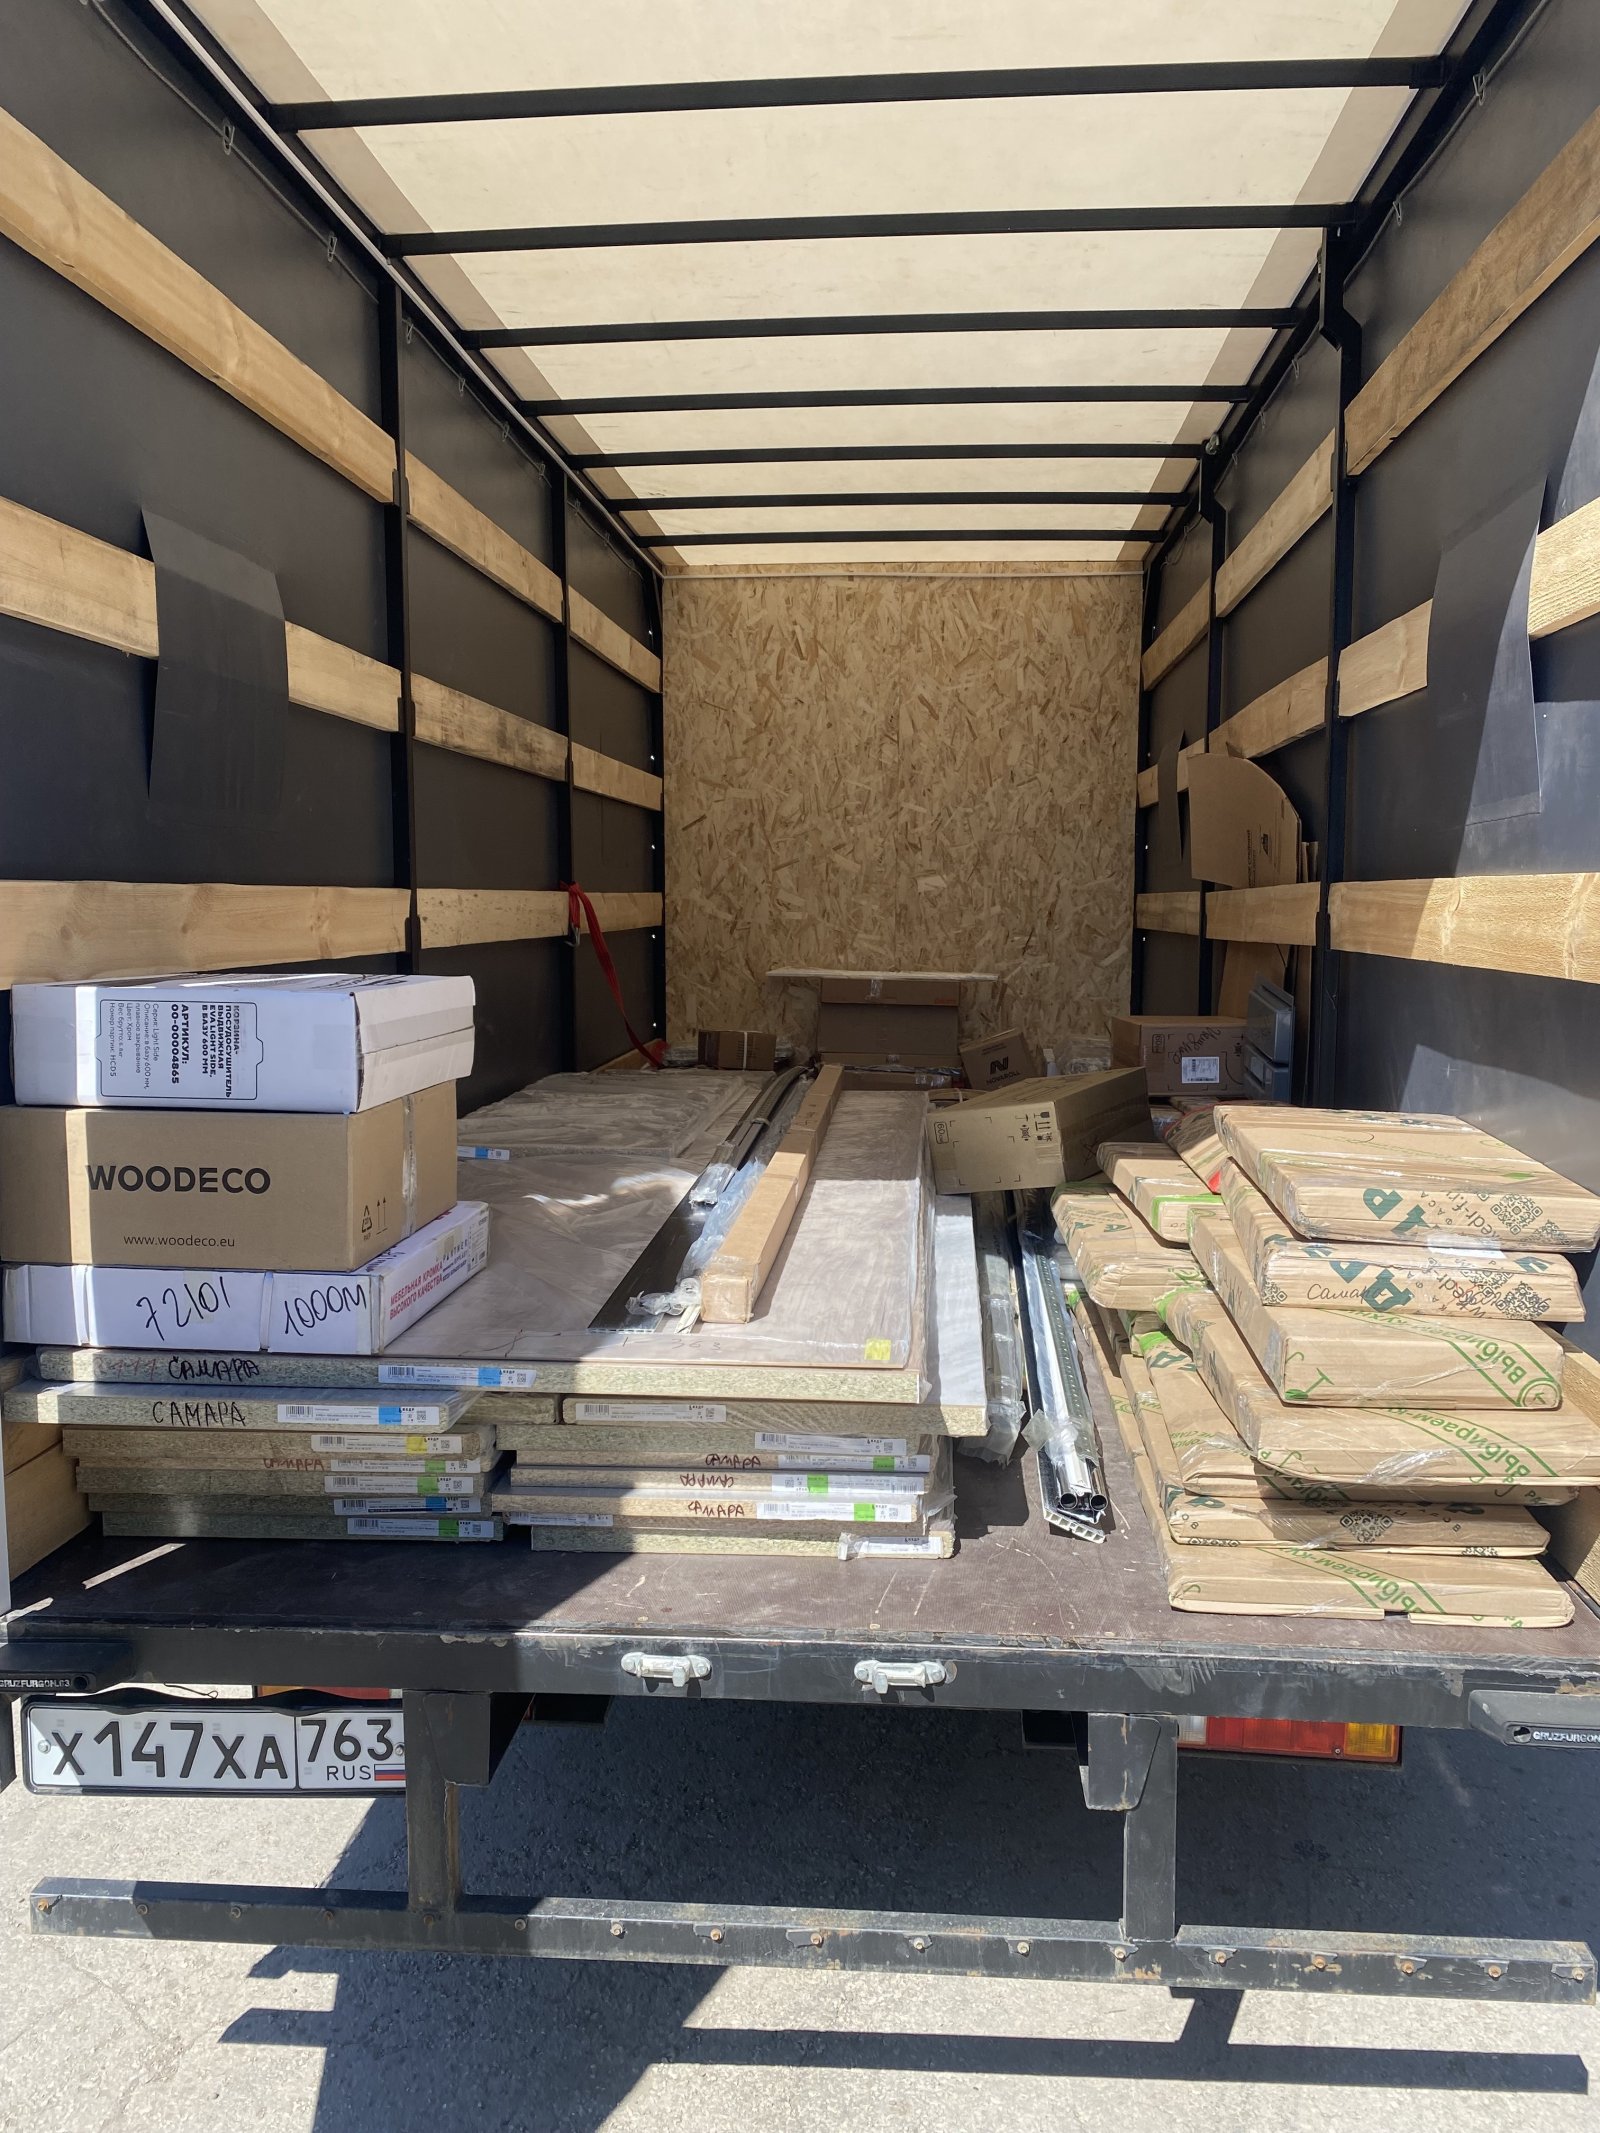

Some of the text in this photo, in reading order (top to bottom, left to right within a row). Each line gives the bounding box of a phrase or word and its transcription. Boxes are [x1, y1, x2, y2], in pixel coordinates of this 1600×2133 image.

[171, 1004, 179, 1084] 00-00004865
[181, 1004, 189, 1064] АРТИКУЛ:
[202, 1058, 208, 1074] ММ
[87, 1165, 271, 1194] WOODECO
[124, 1234, 235, 1247] www.woodeco.eu
[389, 1273, 443, 1320] ВЫСОКОГО КАЧЕСТВА
[390, 1276, 422, 1305] МЕБЕЛЬНАЯ
[422, 1261, 443, 1283] КРОМКА
[152, 1400, 246, 1427] САМАРА
[687, 1500, 746, 1519] САМАРА
[51, 1719, 393, 1780] Х147ХА 763
[326, 1765, 372, 1780] RUS
